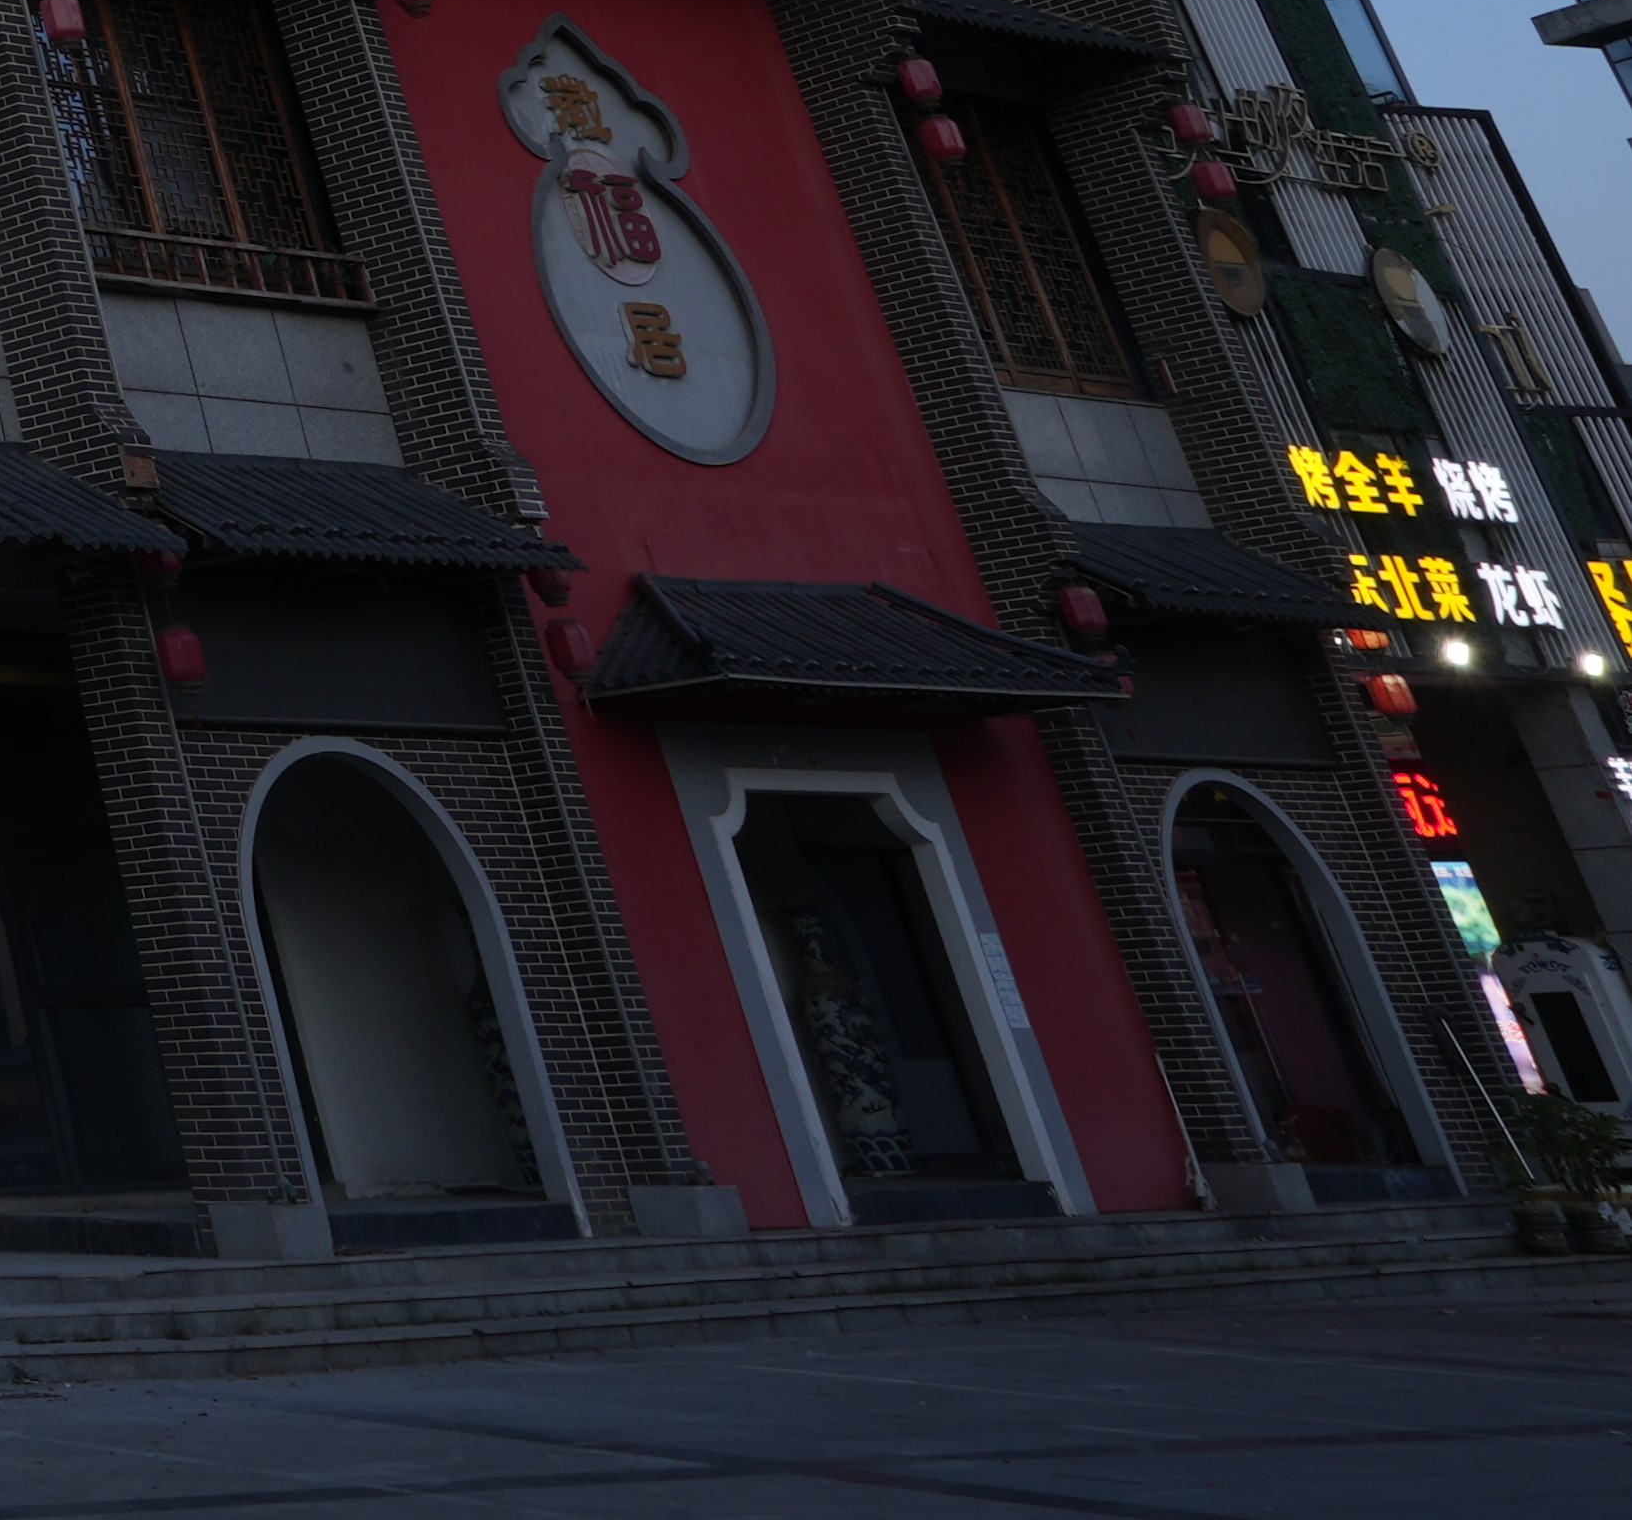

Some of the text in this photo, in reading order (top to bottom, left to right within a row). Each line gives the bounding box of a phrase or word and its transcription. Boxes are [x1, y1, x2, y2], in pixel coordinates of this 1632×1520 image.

[1288, 444, 1520, 524] 烤全羊 烧烤
[1476, 561, 1565, 630] 龙虾
